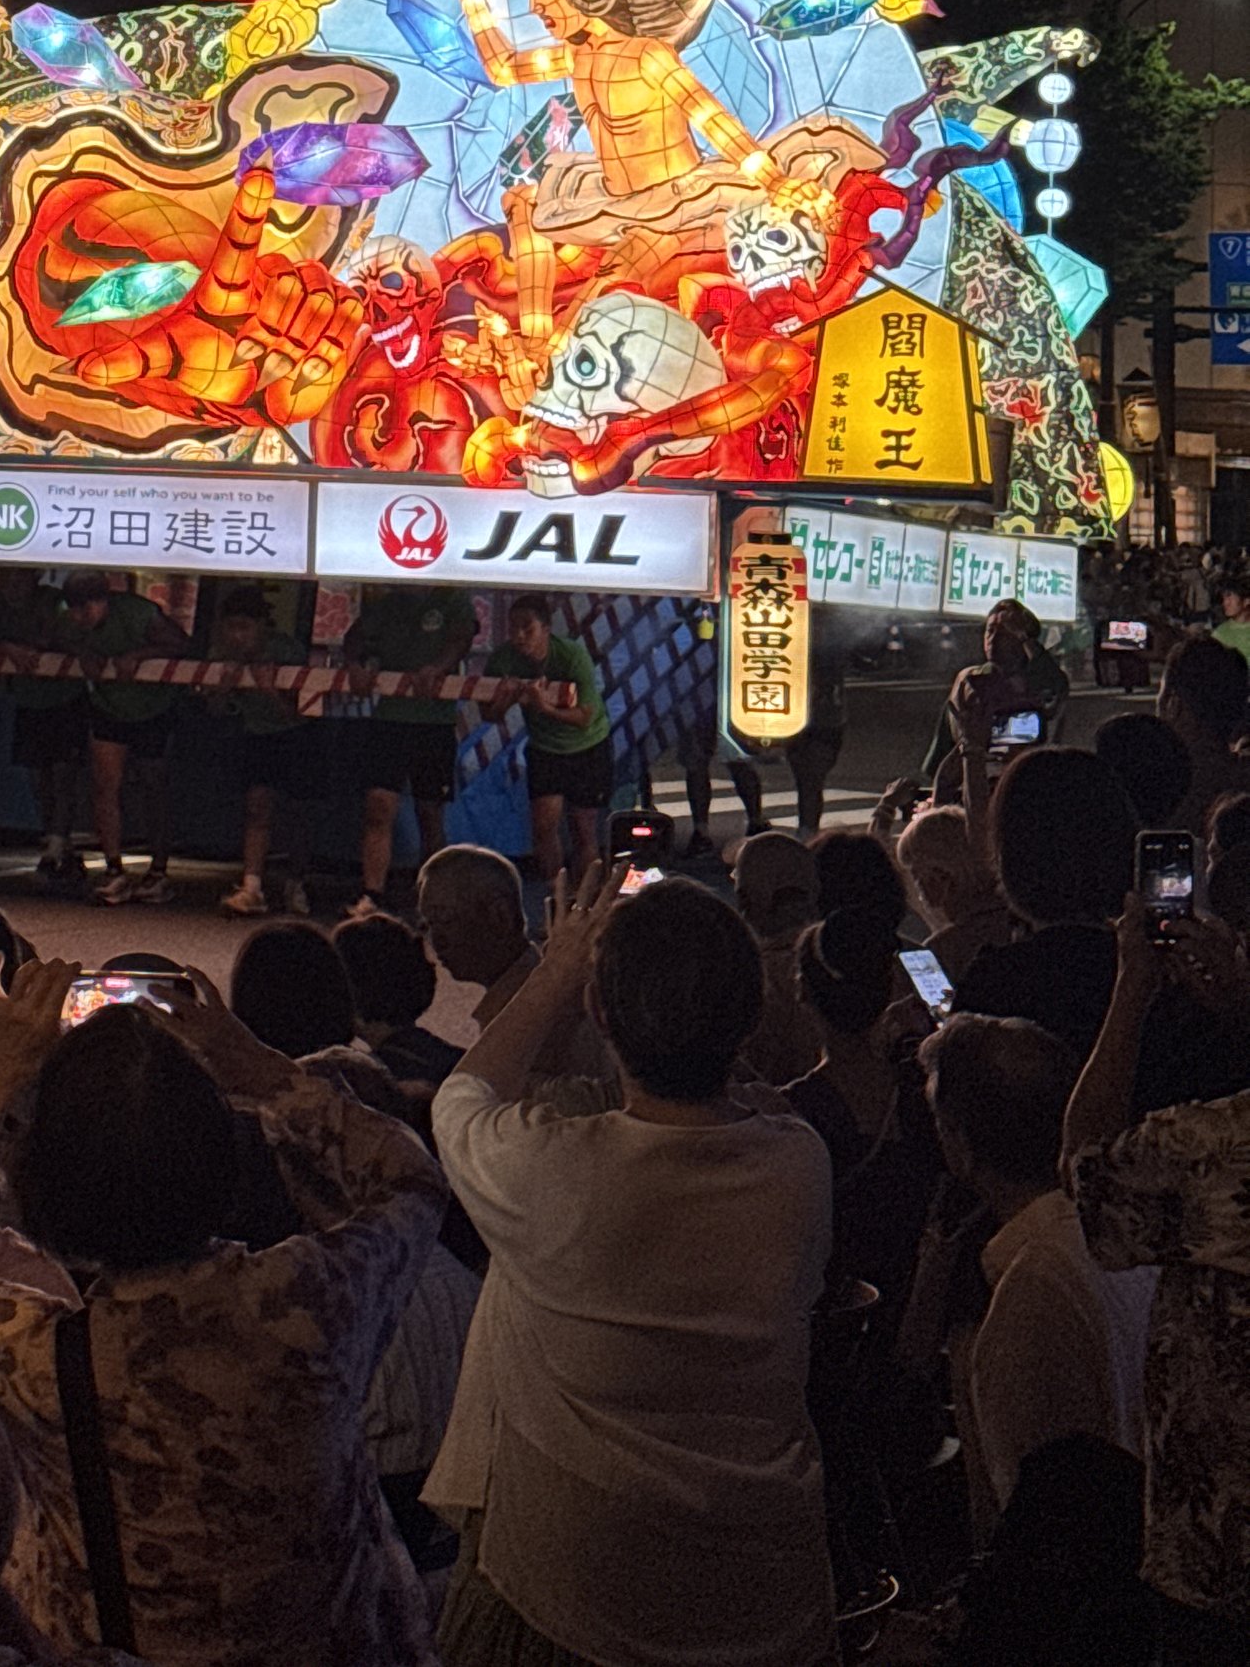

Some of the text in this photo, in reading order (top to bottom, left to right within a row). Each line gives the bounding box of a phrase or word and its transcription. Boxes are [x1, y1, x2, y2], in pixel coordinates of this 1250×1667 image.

[1226, 240, 1235, 253] 7
[874, 312, 928, 472] 閻魔王
[48, 484, 274, 503] Find your self who you want to be
[46, 504, 277, 557] 沼田建設
[395, 546, 434, 561] JAL
[461, 510, 641, 566] JAL
[969, 553, 1012, 597] センコー
[740, 553, 794, 715] 青森山田学園
